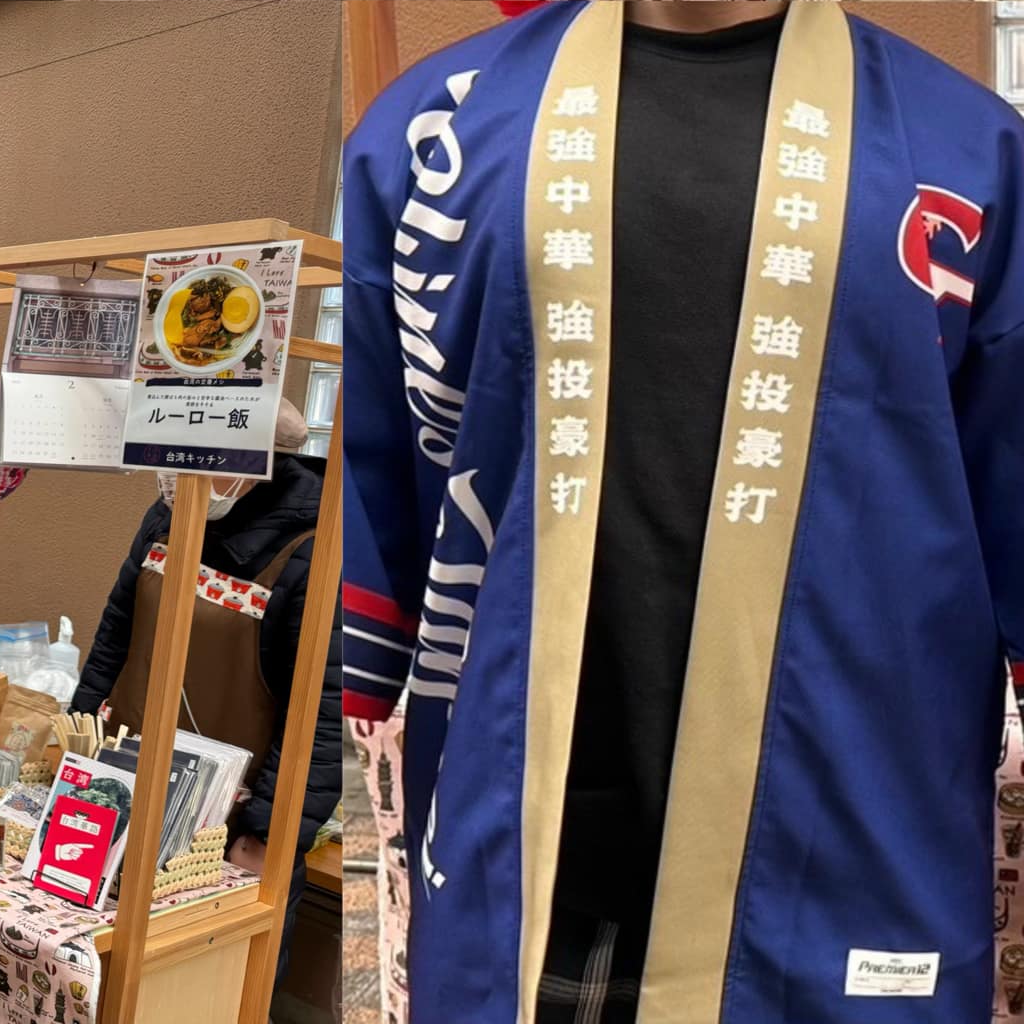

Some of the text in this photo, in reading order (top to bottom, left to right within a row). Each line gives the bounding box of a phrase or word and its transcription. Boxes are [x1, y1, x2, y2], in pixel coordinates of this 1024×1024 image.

[543, 85, 600, 515] 最強中華 強投豪打
[723, 99, 832, 524] 最強中華 強投豪打
[147, 407, 251, 429] ルーロー飯
[165, 451, 227, 465] 台湾キッチン
[63, 768, 90, 786] 台湾
